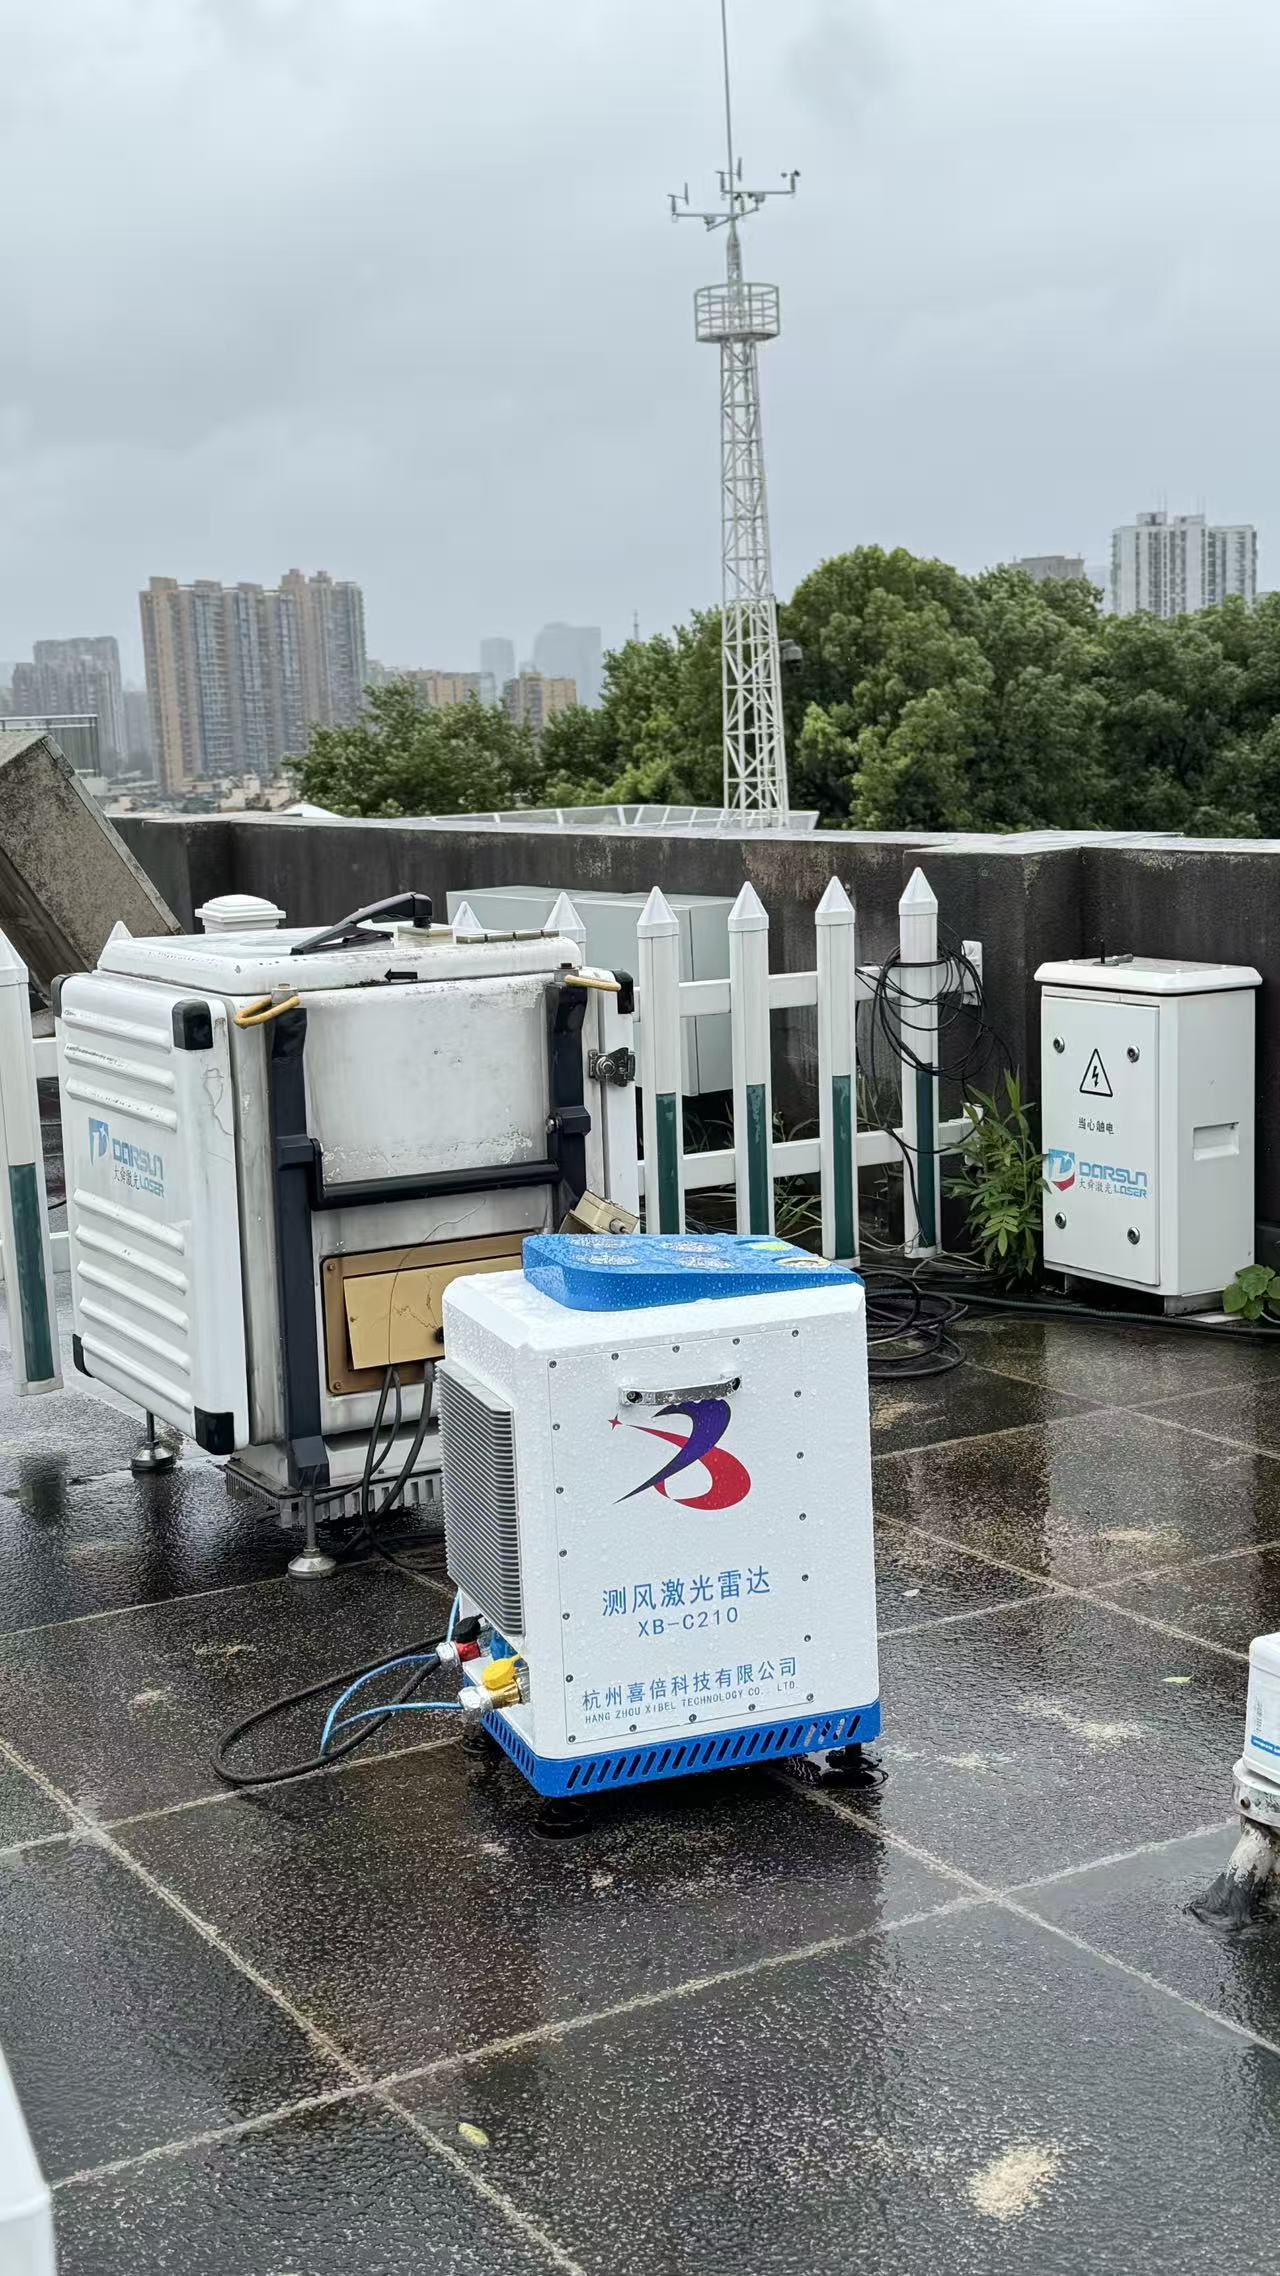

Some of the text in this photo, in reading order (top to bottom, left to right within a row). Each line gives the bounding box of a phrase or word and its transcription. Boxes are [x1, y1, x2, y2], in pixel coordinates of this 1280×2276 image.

[1078, 1117, 1115, 1135] 当心触电
[601, 1565, 771, 1617] 测风激光雷达
[638, 1607, 740, 1638] XB-C210
[582, 1656, 798, 1711] 杭州喜倍科技有限公司
[585, 1711, 611, 1724] HANG
[615, 1706, 641, 1720] ZHOU
[645, 1701, 676, 1714] XIBEL
[682, 1689, 744, 1708] TECHNOLOGY
